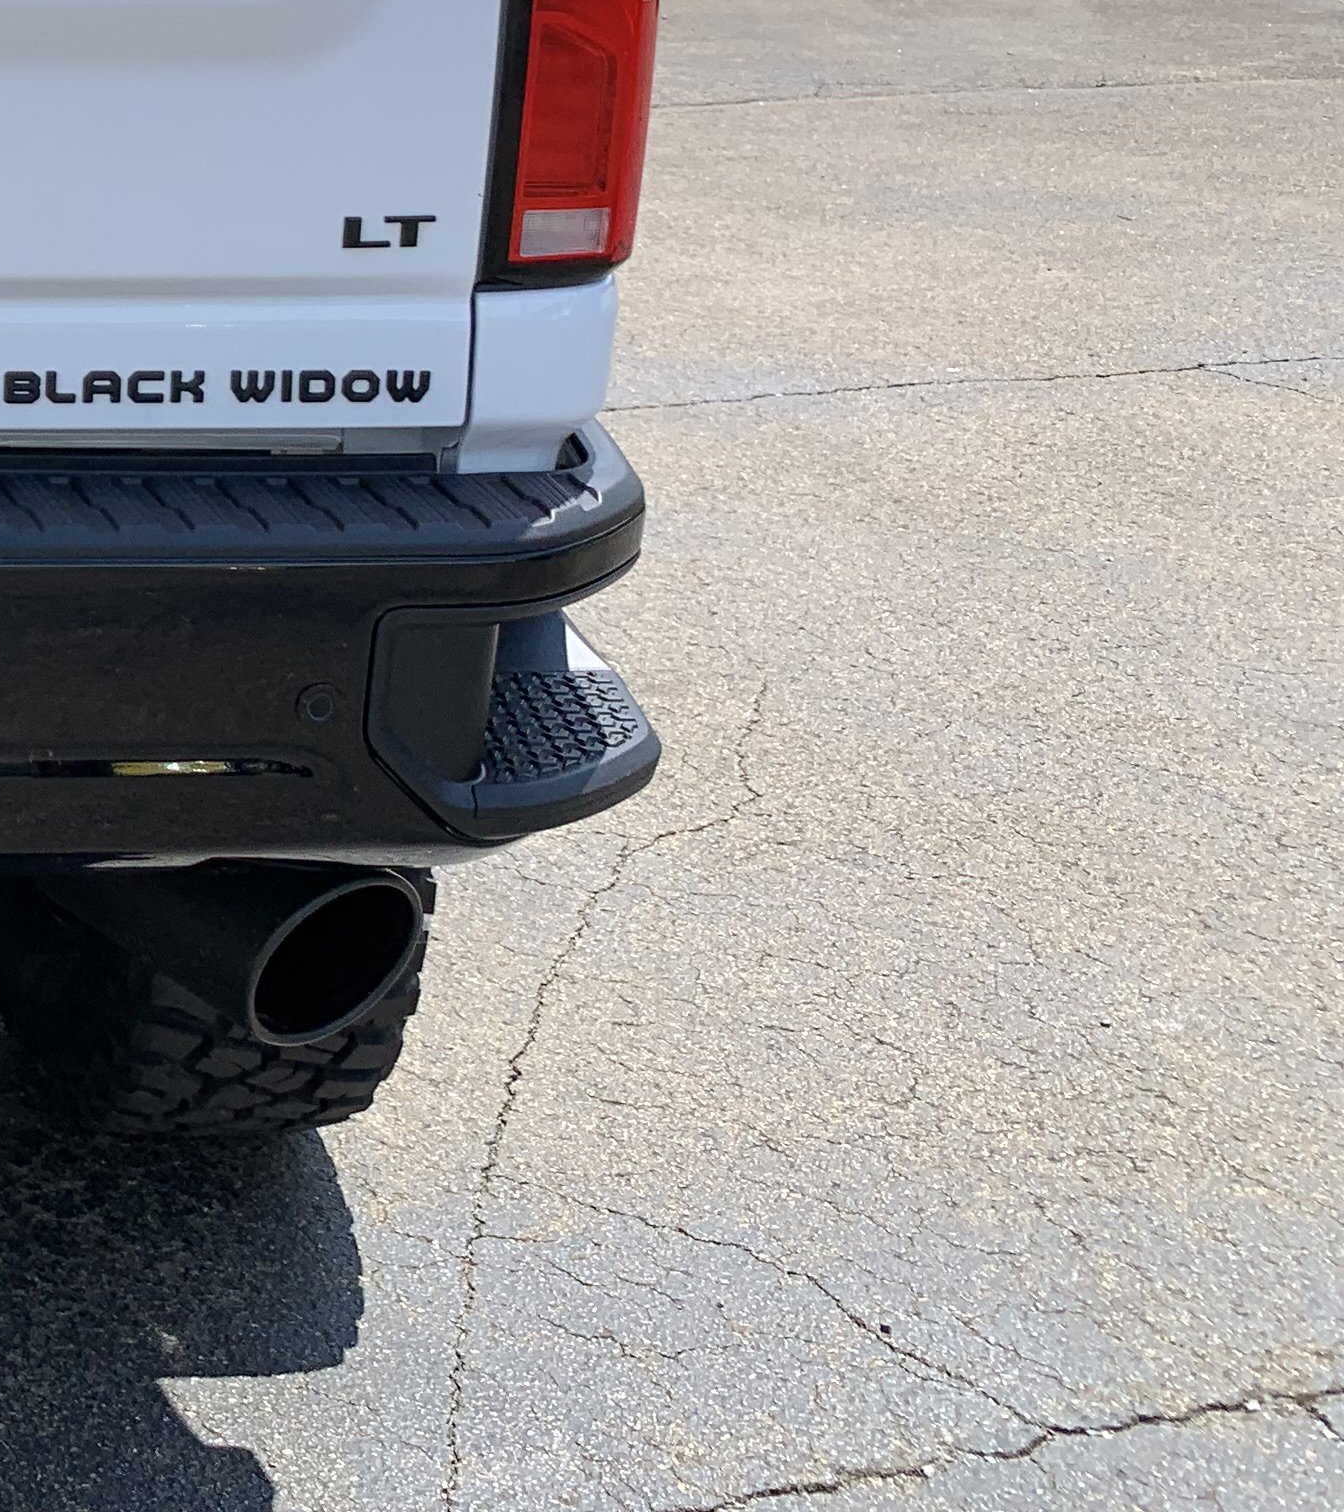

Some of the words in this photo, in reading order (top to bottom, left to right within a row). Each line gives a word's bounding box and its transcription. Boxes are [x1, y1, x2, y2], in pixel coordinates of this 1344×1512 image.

[341, 214, 437, 249] LT
[2, 369, 206, 405] BLACK
[229, 369, 432, 404] WIDOW
